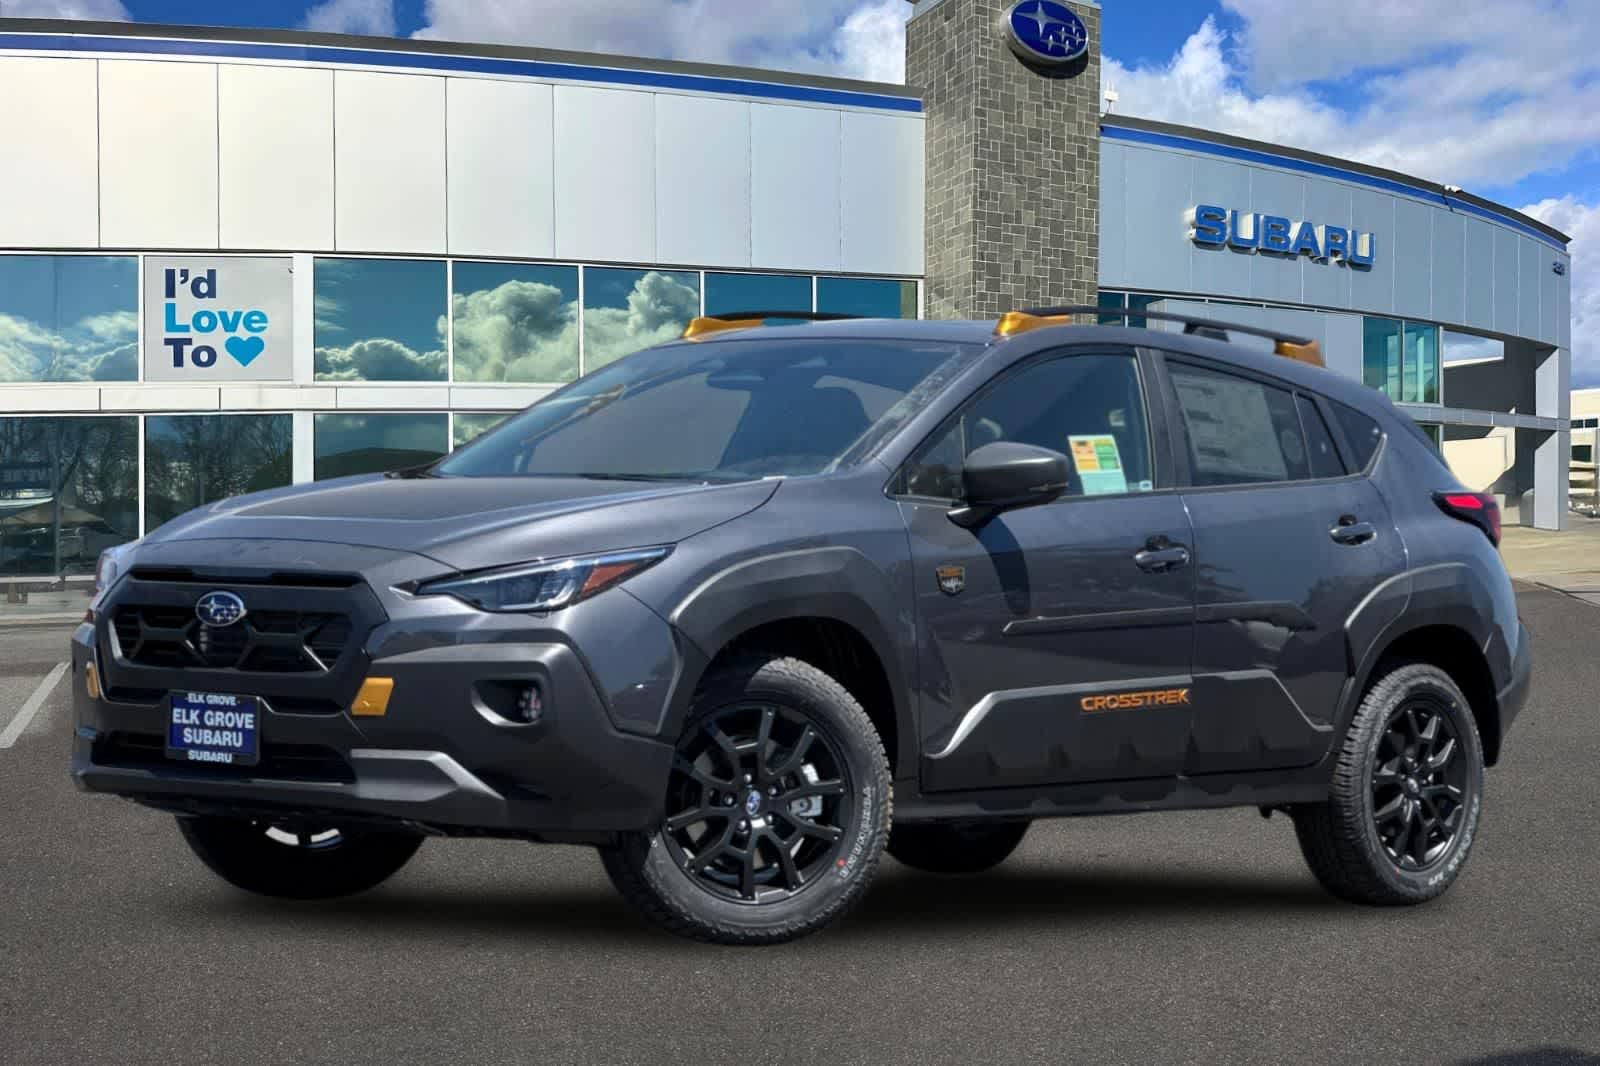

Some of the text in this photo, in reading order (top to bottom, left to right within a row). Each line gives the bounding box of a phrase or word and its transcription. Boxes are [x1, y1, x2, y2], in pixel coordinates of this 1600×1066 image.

[1191, 204, 1376, 271] SUBARU
[165, 268, 217, 299] I’d
[165, 302, 268, 333] Love
[163, 337, 217, 368] To
[187, 692, 237, 706] ELK GROVE
[1081, 688, 1190, 712] CROSSTREK
[172, 707, 255, 729] ELK GROVE
[183, 727, 243, 748] SUBARU
[188, 750, 233, 763] SUBARU
